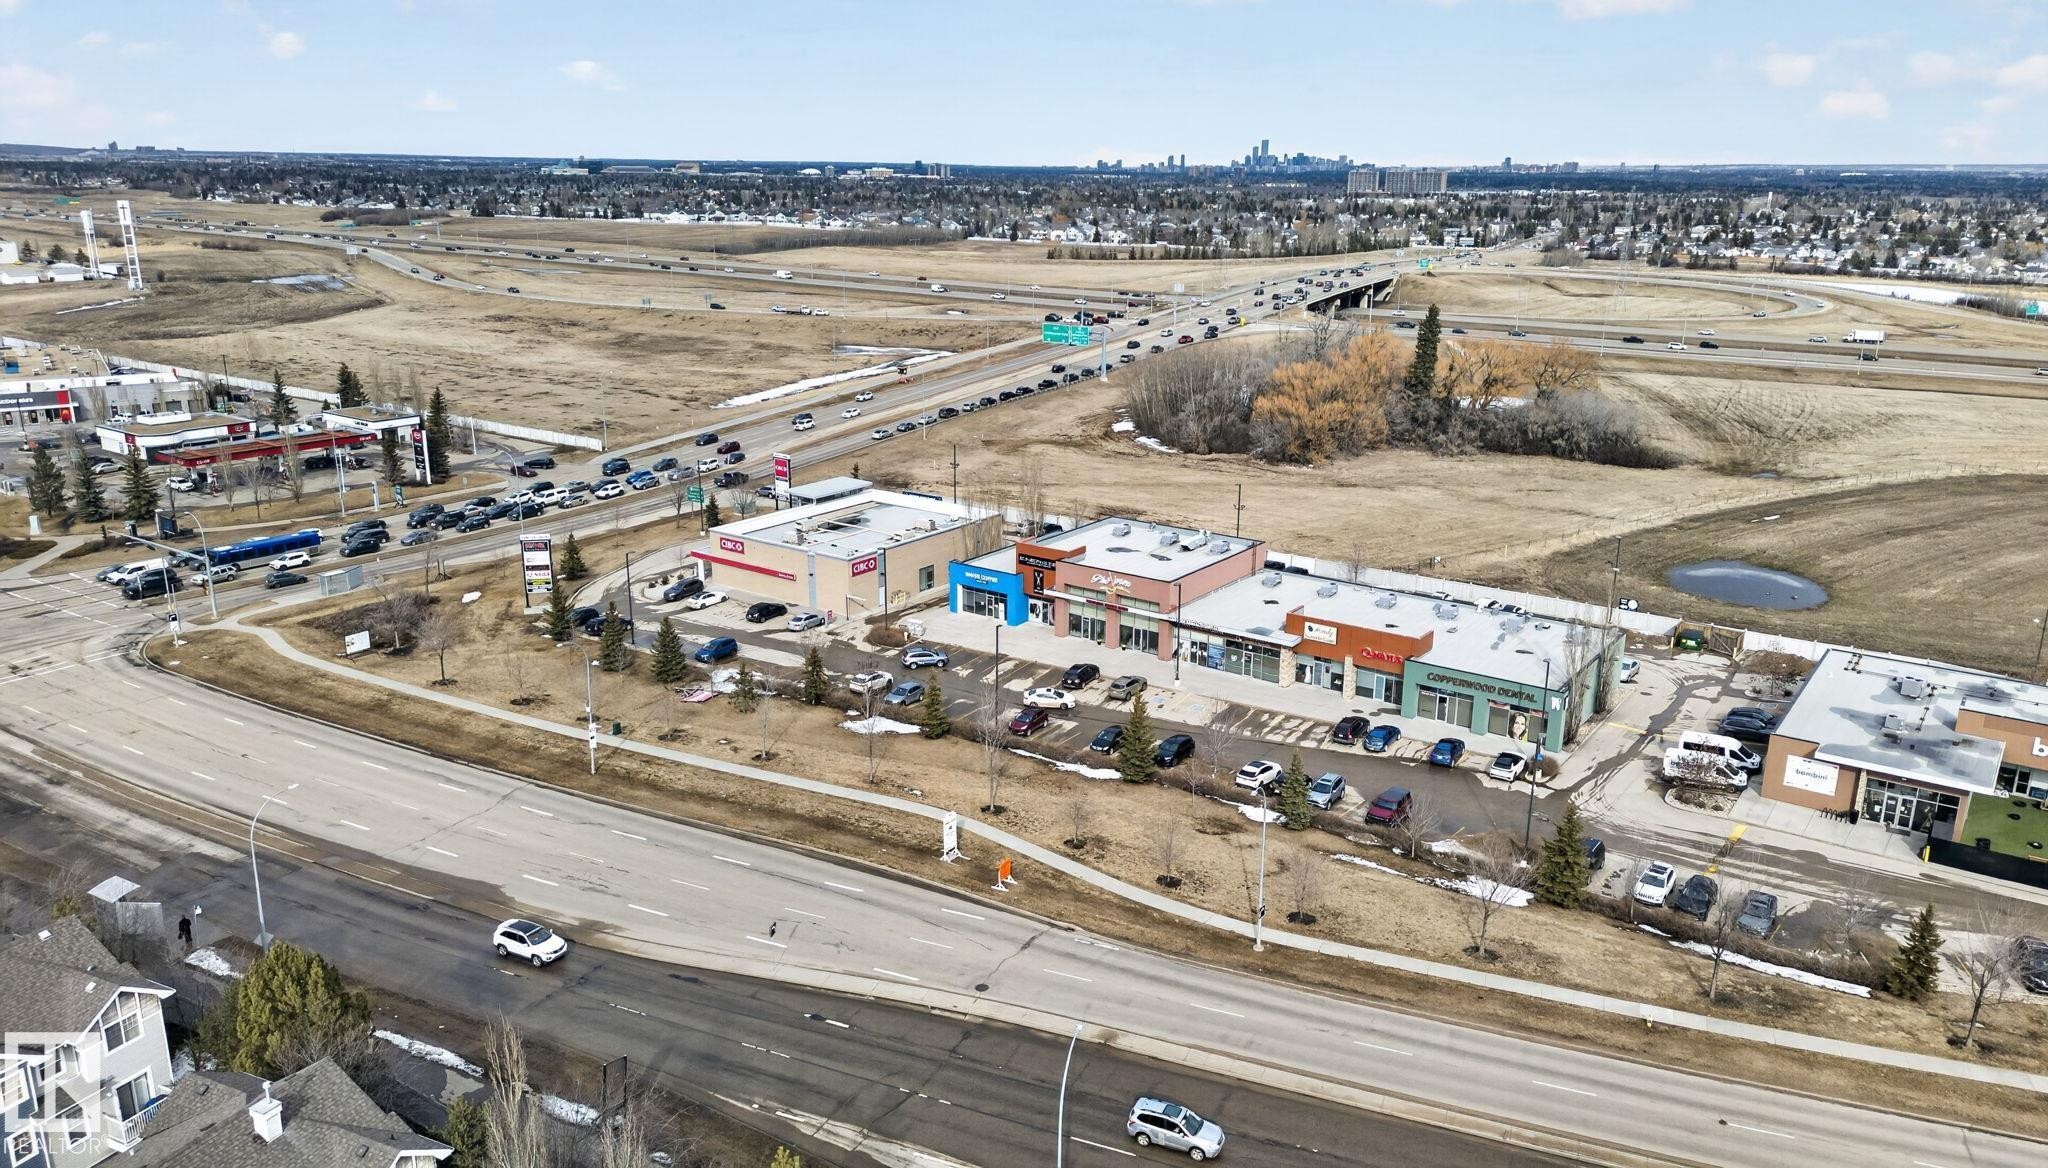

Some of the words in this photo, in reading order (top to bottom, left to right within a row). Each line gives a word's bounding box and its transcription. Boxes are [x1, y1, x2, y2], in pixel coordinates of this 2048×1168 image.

[721, 540, 737, 549] CIBC
[853, 561, 869, 573] CIBC
[1427, 672, 1496, 693] COPPERWOOD
[1497, 686, 1538, 703] DENTAL
[1795, 767, 1828, 780] bambini
